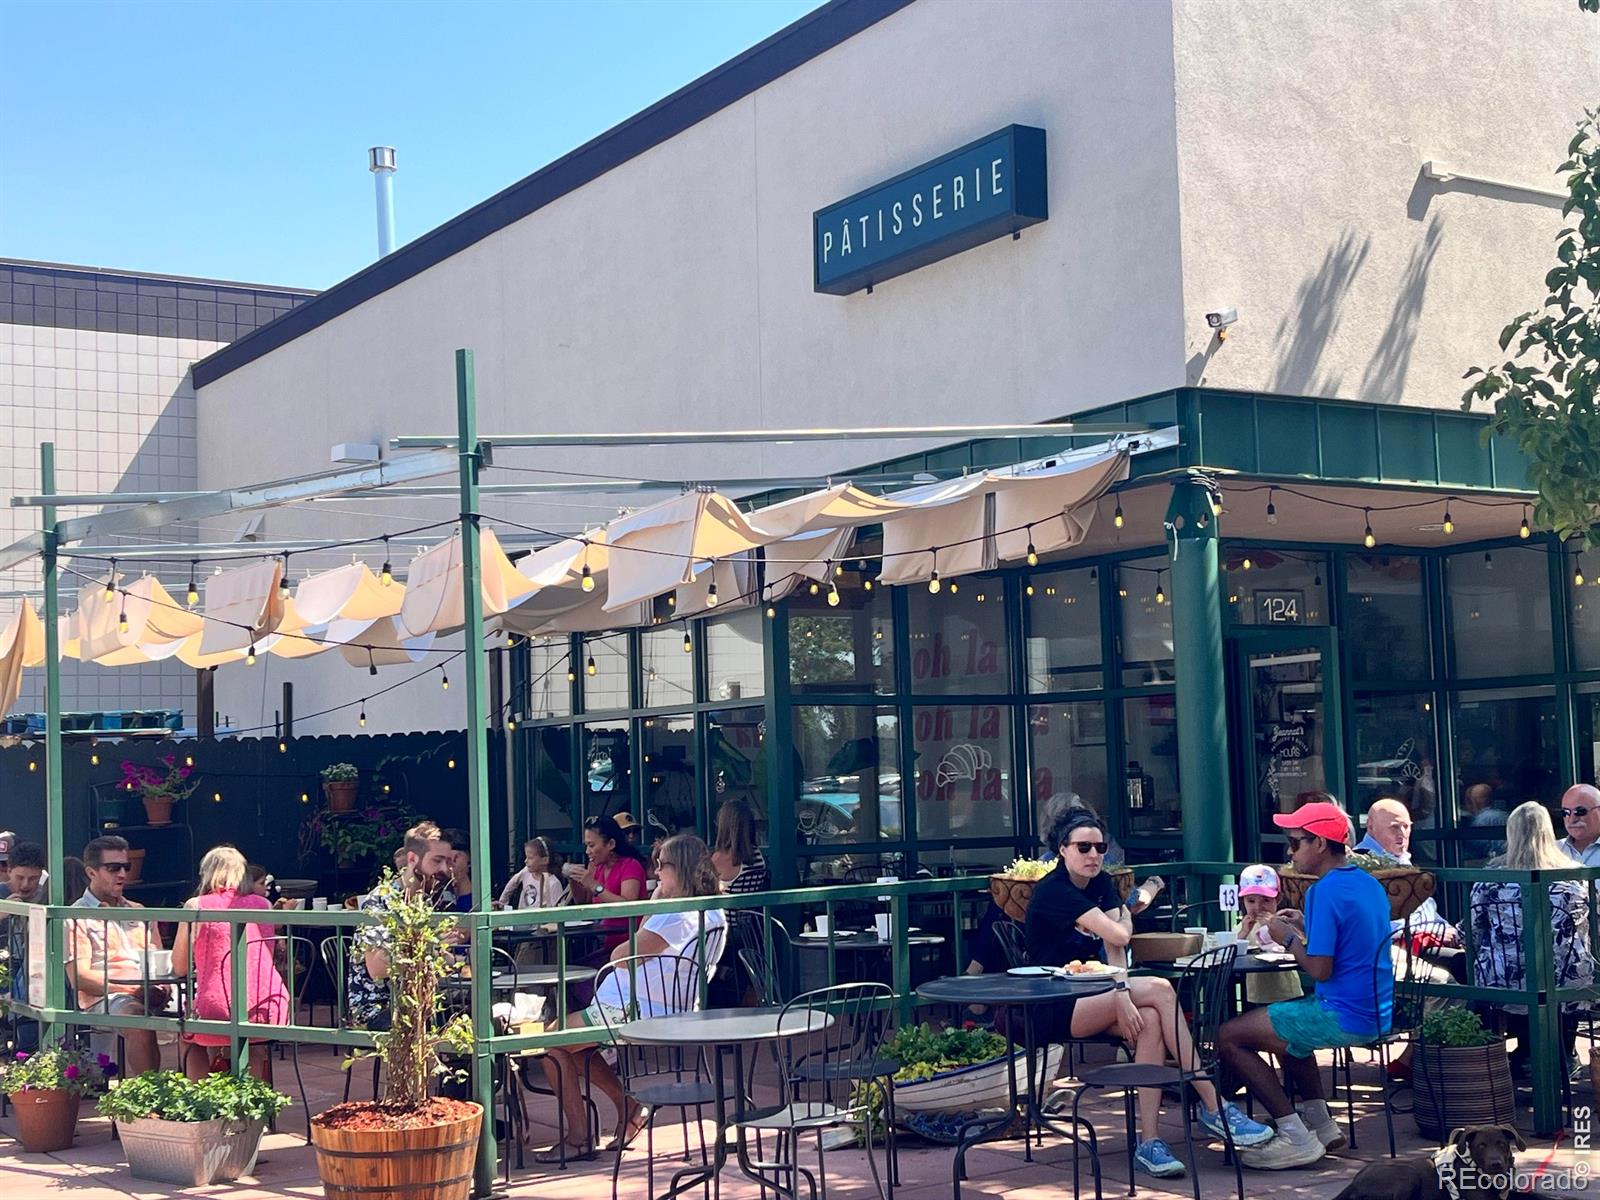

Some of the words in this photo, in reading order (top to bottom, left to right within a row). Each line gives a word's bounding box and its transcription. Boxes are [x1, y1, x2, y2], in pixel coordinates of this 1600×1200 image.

[823, 158, 1003, 264] PÂTISSERIE
[1264, 598, 1298, 622] 124
[913, 632, 950, 680] oh
[966, 629, 999, 675] la
[915, 705, 953, 742] oh
[968, 705, 1000, 740] la
[1223, 889, 1235, 907] 13
